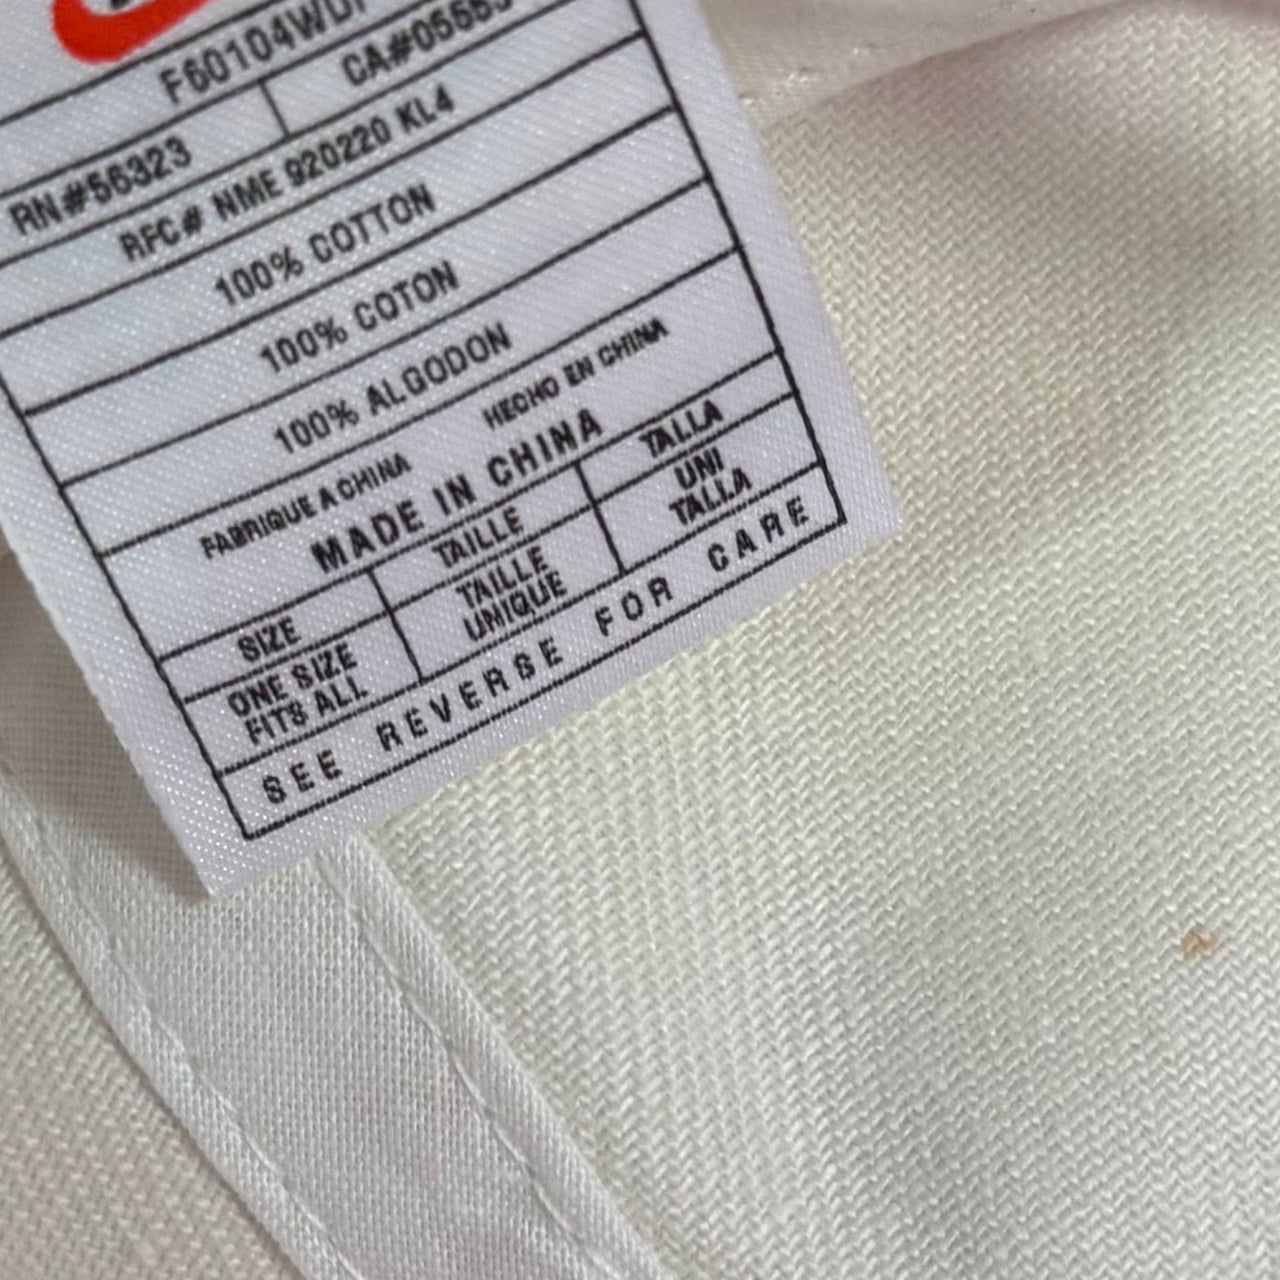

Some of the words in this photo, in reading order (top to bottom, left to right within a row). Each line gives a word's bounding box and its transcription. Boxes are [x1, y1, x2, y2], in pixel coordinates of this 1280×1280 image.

[7, 136, 193, 236] RN#56323
[117, 204, 204, 263] RFC#
[211, 168, 284, 222] NME
[283, 112, 393, 188] 920220
[394, 82, 455, 134] KL4
[214, 244, 306, 308] 100%
[307, 181, 437, 266] COTTON
[259, 317, 349, 374] 100%
[352, 259, 461, 332] COTON
[272, 398, 361, 456] 100%
[365, 321, 513, 418] ALGODON
[481, 377, 561, 431] HECHO
[564, 356, 596, 387] EN
[596, 316, 670, 370] CHINA
[638, 398, 725, 459] TALLA
[673, 445, 726, 491] UNI
[199, 494, 318, 560] FABRIQUE
[319, 484, 339, 508] A
[336, 451, 414, 502] CHINA
[309, 498, 426, 574] MADE
[431, 472, 478, 517] IN
[486, 407, 604, 489] CHINA
[668, 466, 754, 526] TALLA
[431, 505, 525, 569] TAILLE
[455, 544, 550, 611] TAILLE
[235, 614, 303, 664] SIZE
[261, 747, 344, 807] SEE
[375, 635, 565, 754] REVERSE
[593, 574, 675, 638] FOR
[705, 494, 812, 574] CARE
[462, 570, 569, 643] UNIQUE
[226, 672, 291, 719] ONE
[291, 641, 359, 692] SIZE
[243, 700, 310, 747] FITS
[312, 674, 370, 719] ALL
